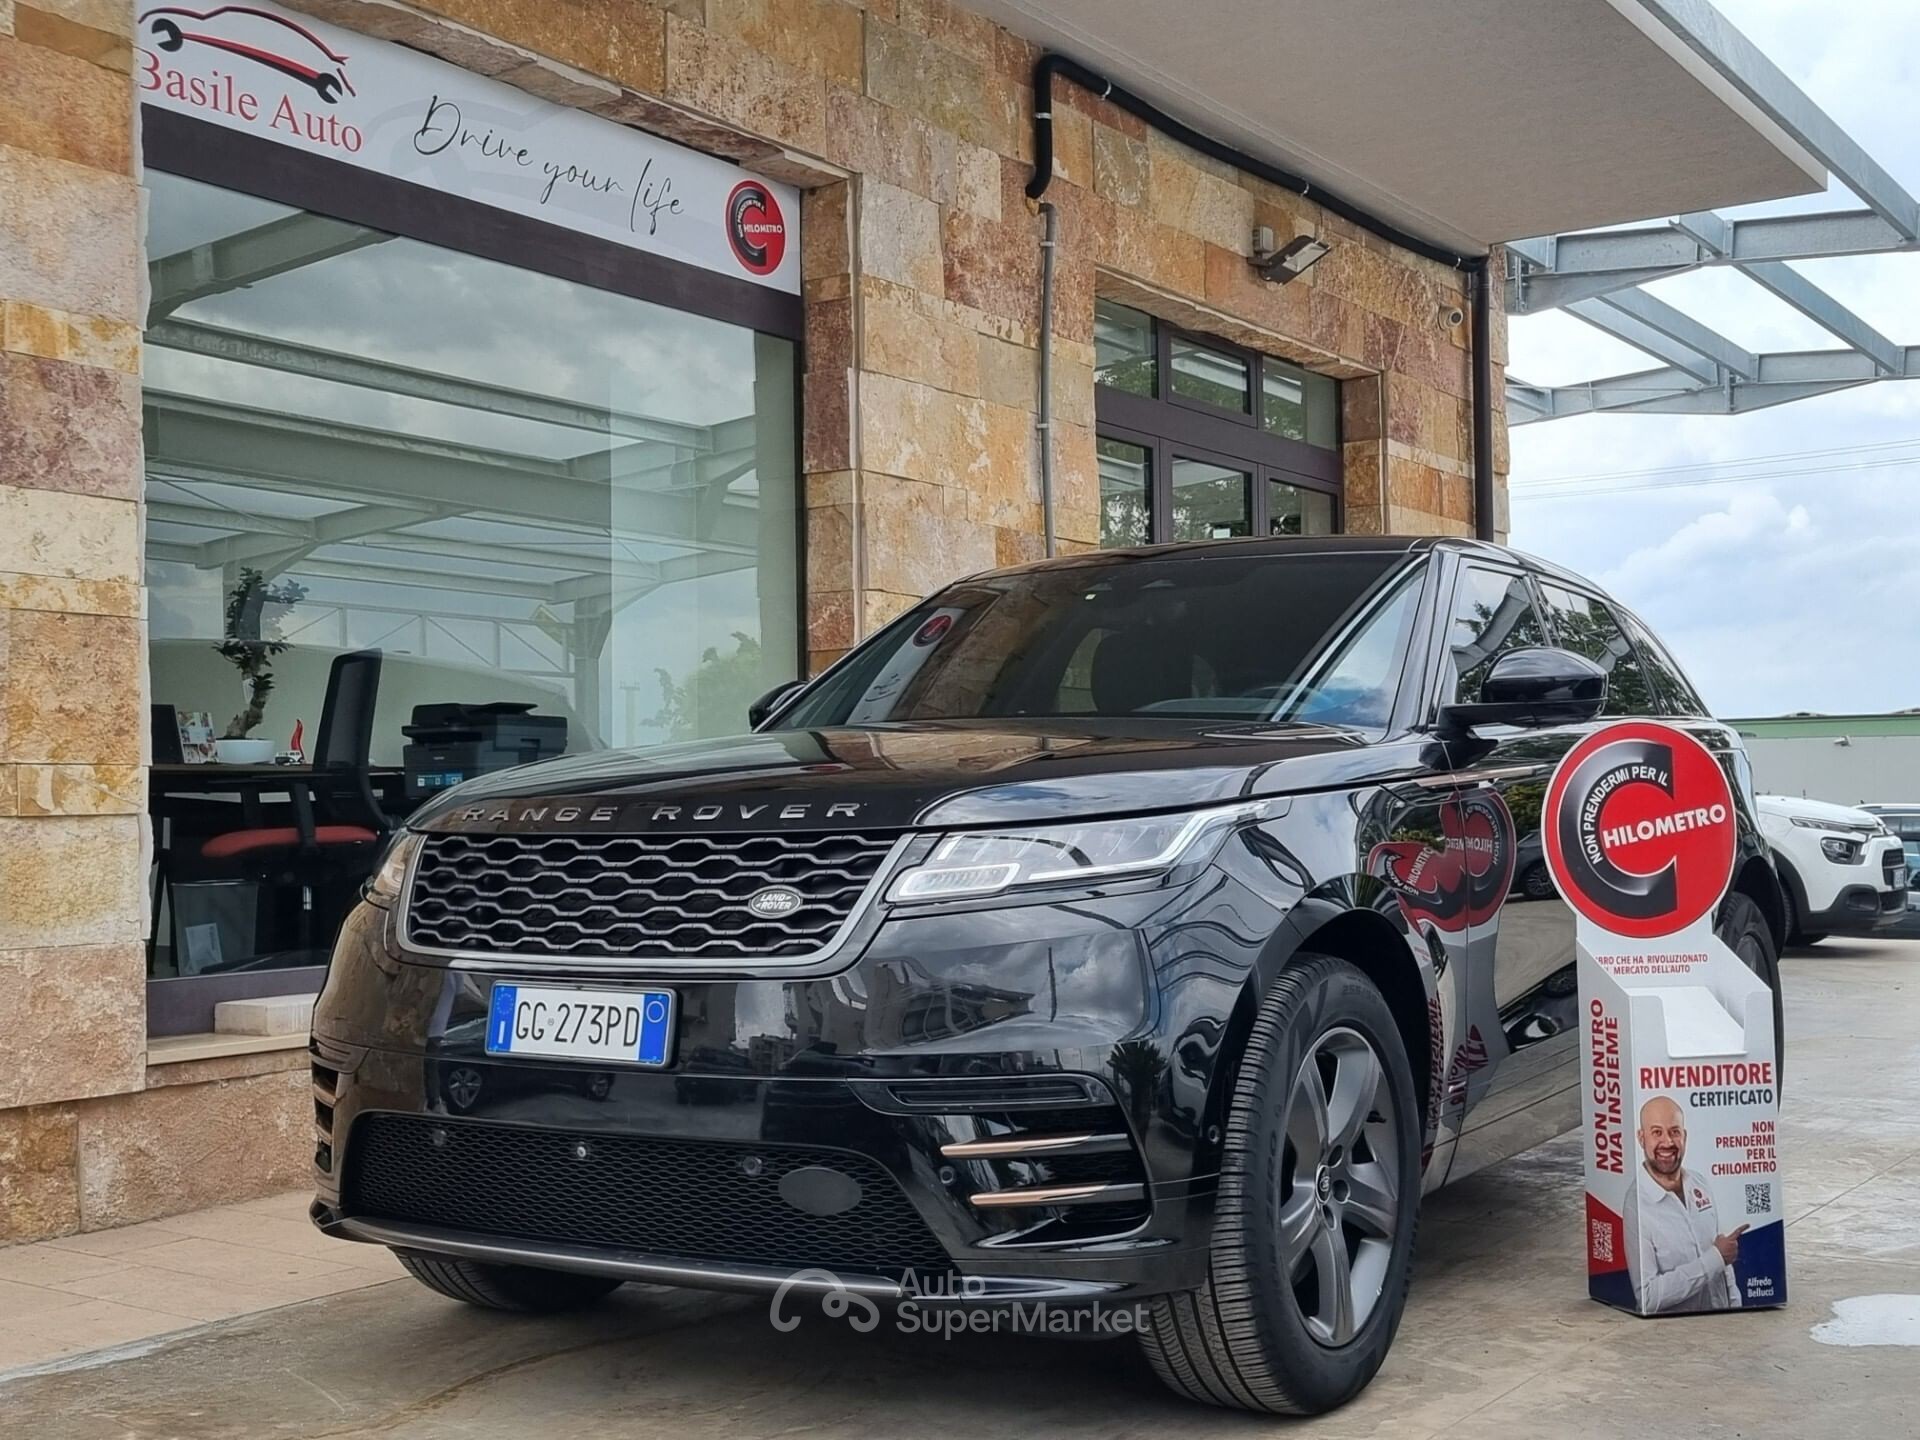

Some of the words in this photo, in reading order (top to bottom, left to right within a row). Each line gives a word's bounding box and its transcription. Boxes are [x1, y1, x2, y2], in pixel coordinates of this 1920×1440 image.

[139, 49, 259, 121] Basile
[268, 95, 363, 152] Auto
[412, 94, 534, 167] Drive
[539, 160, 625, 204] your
[629, 158, 685, 236] life
[1631, 766, 1657, 780] PER
[1658, 770, 1668, 786] IL
[1583, 767, 1630, 831] PRENDERMI
[461, 805, 619, 823] RANGE
[651, 802, 861, 821] ROVER
[1602, 803, 1726, 849] HILOMETRO
[1583, 834, 1604, 865] NON
[760, 894, 787, 902] LAND
[760, 901, 792, 910] ROVER
[1616, 956, 1632, 965] CHE
[1633, 955, 1644, 964] HA
[1647, 953, 1708, 964] RIVOLUZIONATO
[1613, 966, 1650, 975] MERCATO
[1651, 965, 1691, 974] DELL'AUTO
[515, 1001, 547, 1041] GG
[554, 1003, 640, 1047] 273PD
[1590, 999, 1607, 1105] CONTRO
[1605, 1016, 1623, 1125] INSIEME
[1639, 1062, 1773, 1090] RIVENDITORE
[1689, 1089, 1773, 1107] CERTIFICATO
[1752, 1121, 1775, 1133] NON
[1594, 1112, 1609, 1171] NON
[1715, 1134, 1776, 1148] PRENDERMI
[1609, 1132, 1624, 1174] MA
[1746, 1148, 1766, 1160] PER
[1767, 1148, 1777, 1159] IL
[1711, 1161, 1777, 1175] CHILOMETRO
[1747, 1277, 1773, 1287] Alfredo
[1747, 1288, 1775, 1298] Bellucci
